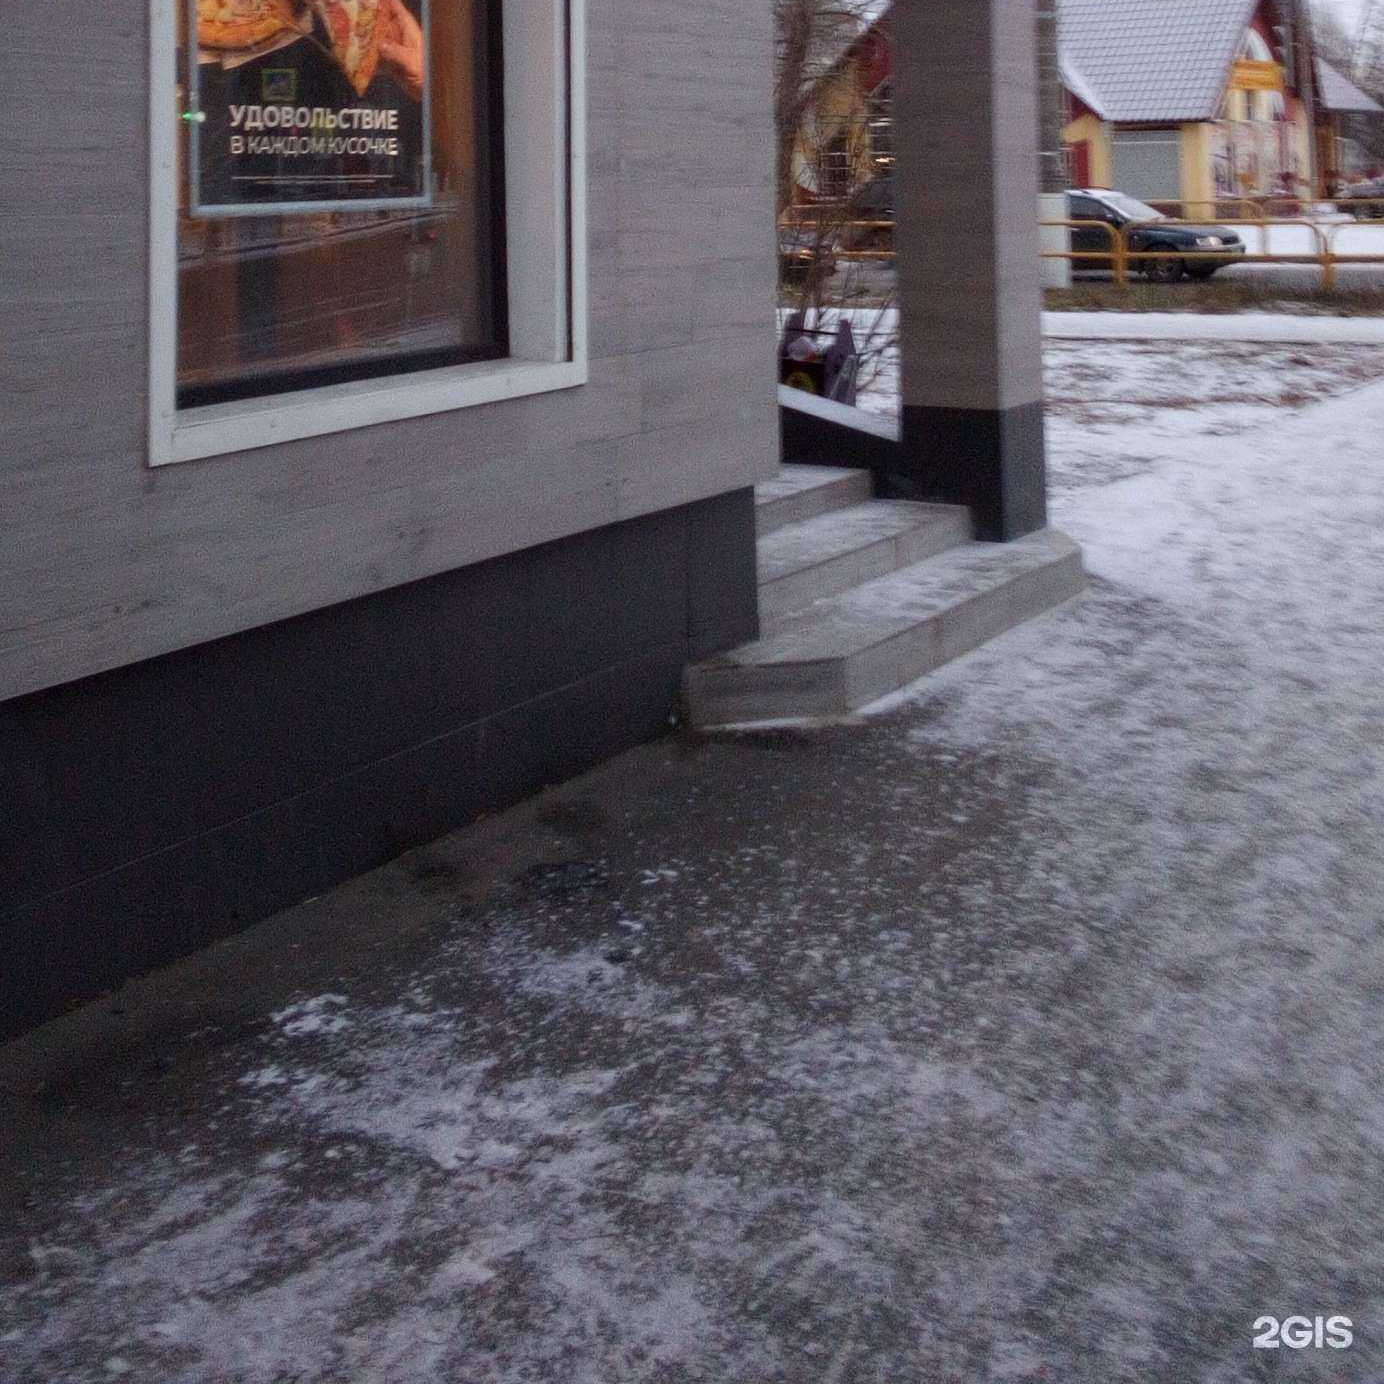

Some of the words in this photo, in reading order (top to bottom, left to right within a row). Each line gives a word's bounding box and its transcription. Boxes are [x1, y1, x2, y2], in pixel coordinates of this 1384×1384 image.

[228, 104, 399, 131] УДОВОЛЬСТВИЕ
[230, 135, 244, 154] В
[248, 135, 325, 157] КАЖДОМ
[327, 136, 399, 156] КУСОЧКЕ
